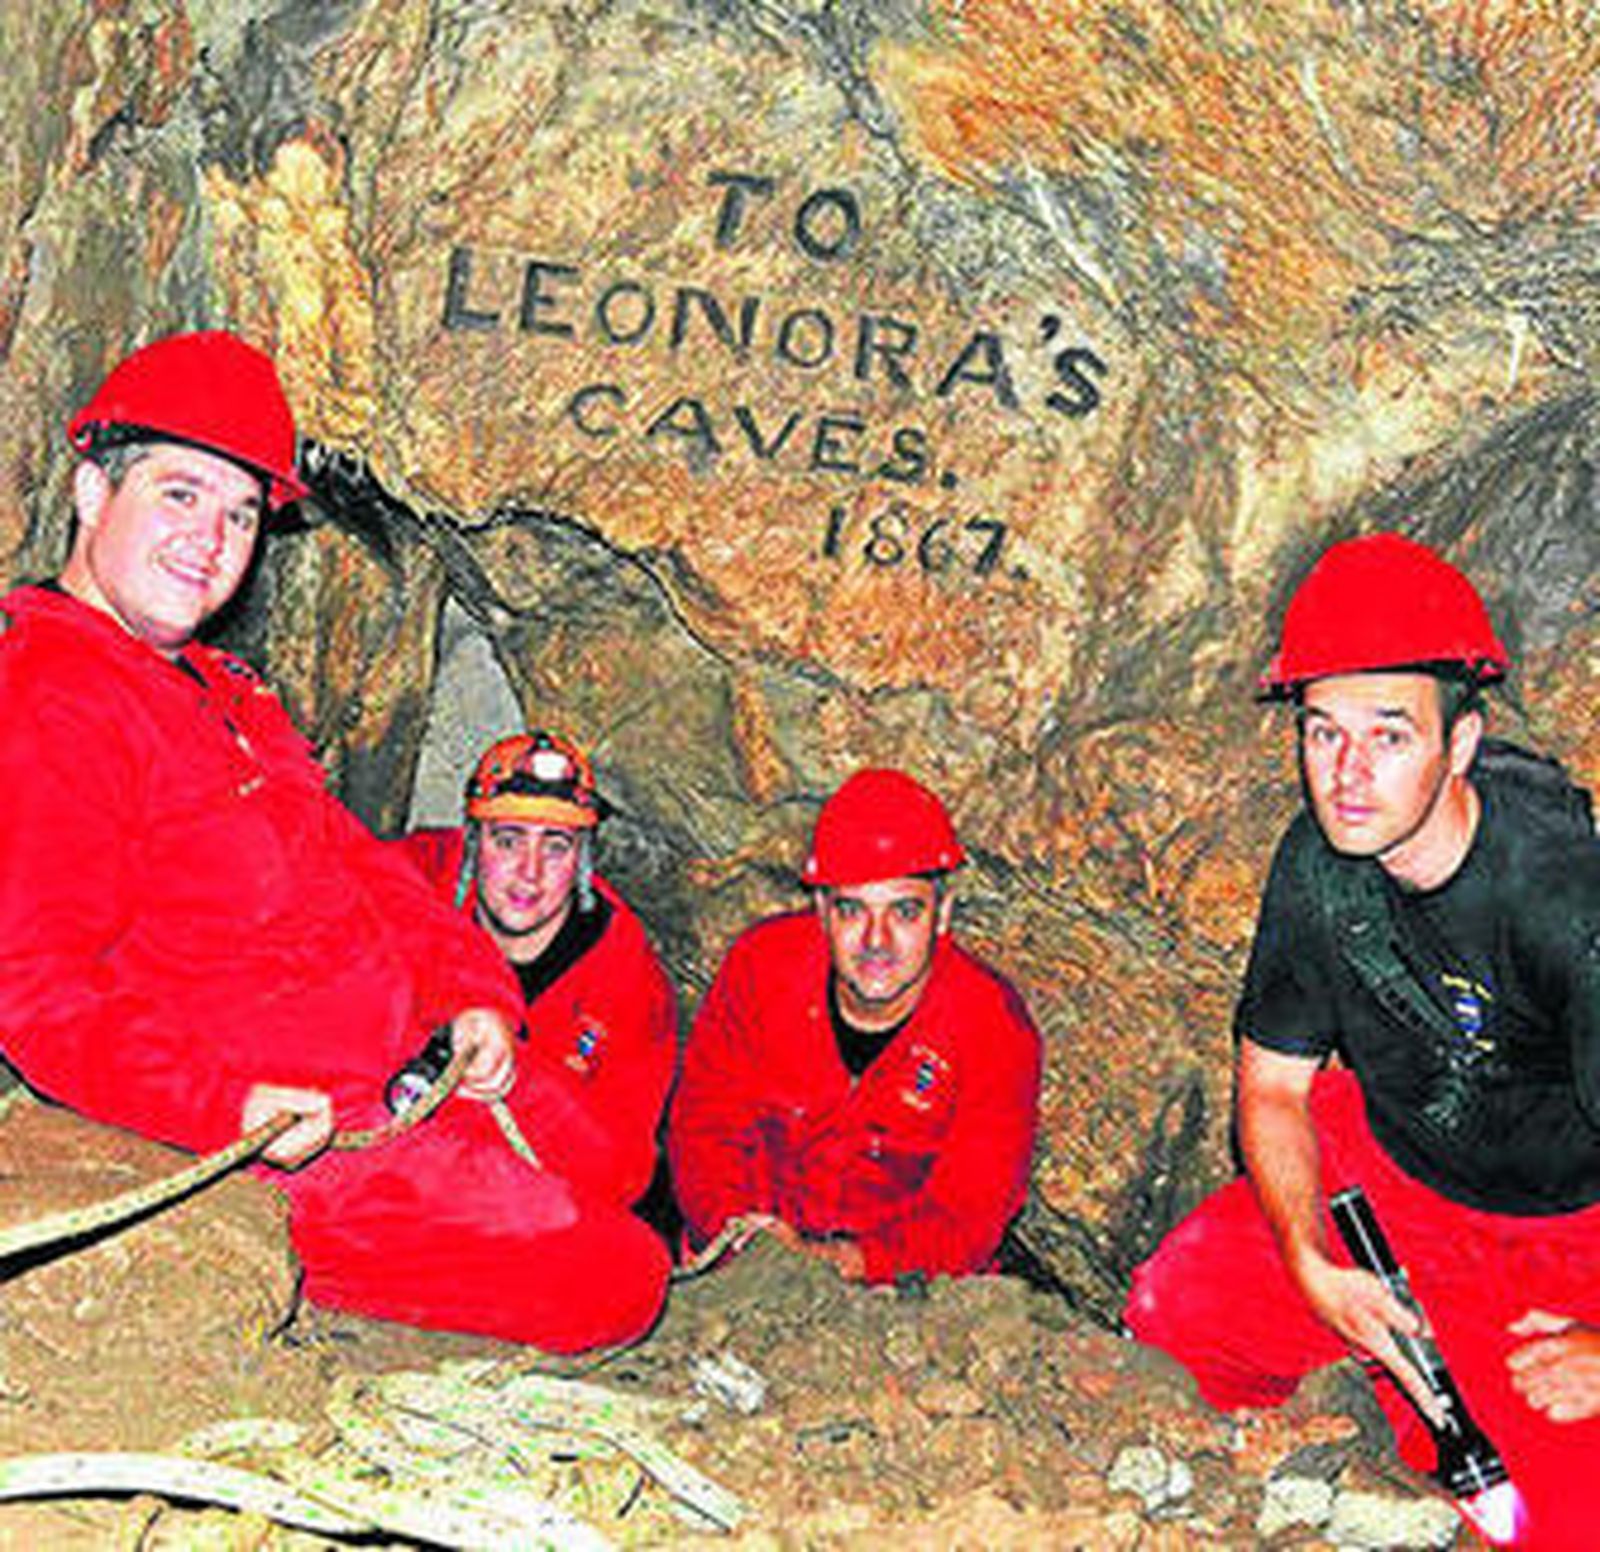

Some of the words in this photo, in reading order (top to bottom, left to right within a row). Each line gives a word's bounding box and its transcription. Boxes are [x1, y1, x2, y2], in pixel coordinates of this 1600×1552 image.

[708, 172, 862, 260] TO
[441, 247, 1109, 418] LEONORA'S
[568, 384, 958, 489] CAVES.
